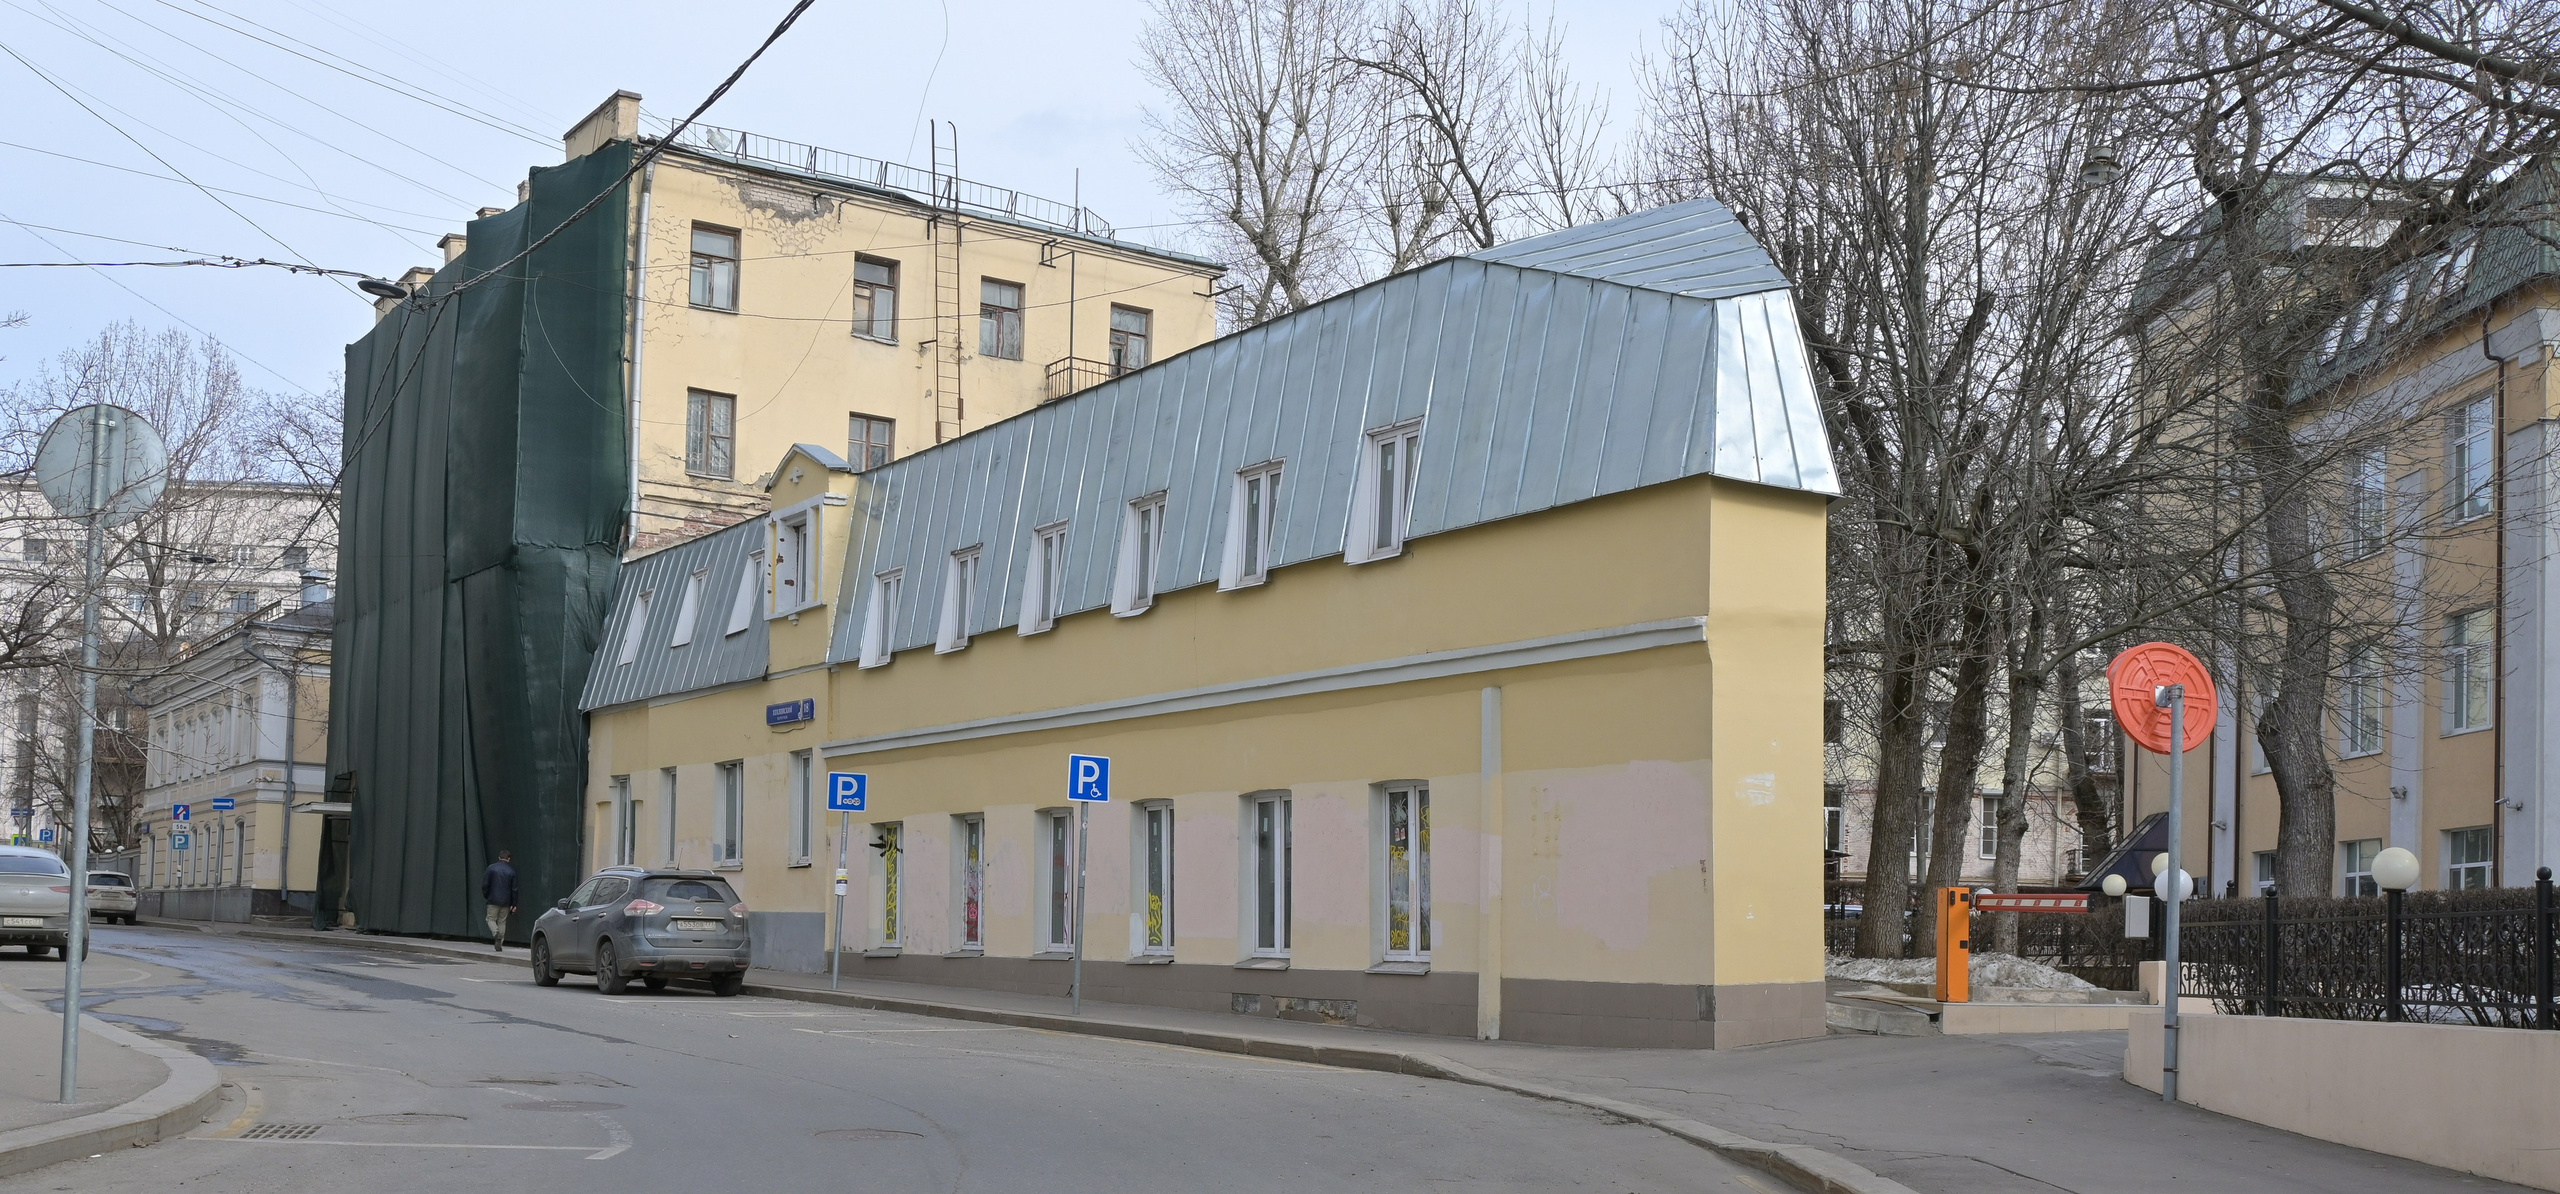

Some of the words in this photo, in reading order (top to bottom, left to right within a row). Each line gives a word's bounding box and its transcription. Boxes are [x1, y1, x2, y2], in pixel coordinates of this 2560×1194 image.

[1077, 759, 1100, 794] P
[836, 776, 858, 806] P
[42, 830, 51, 840] P
[175, 835, 186, 849] P
